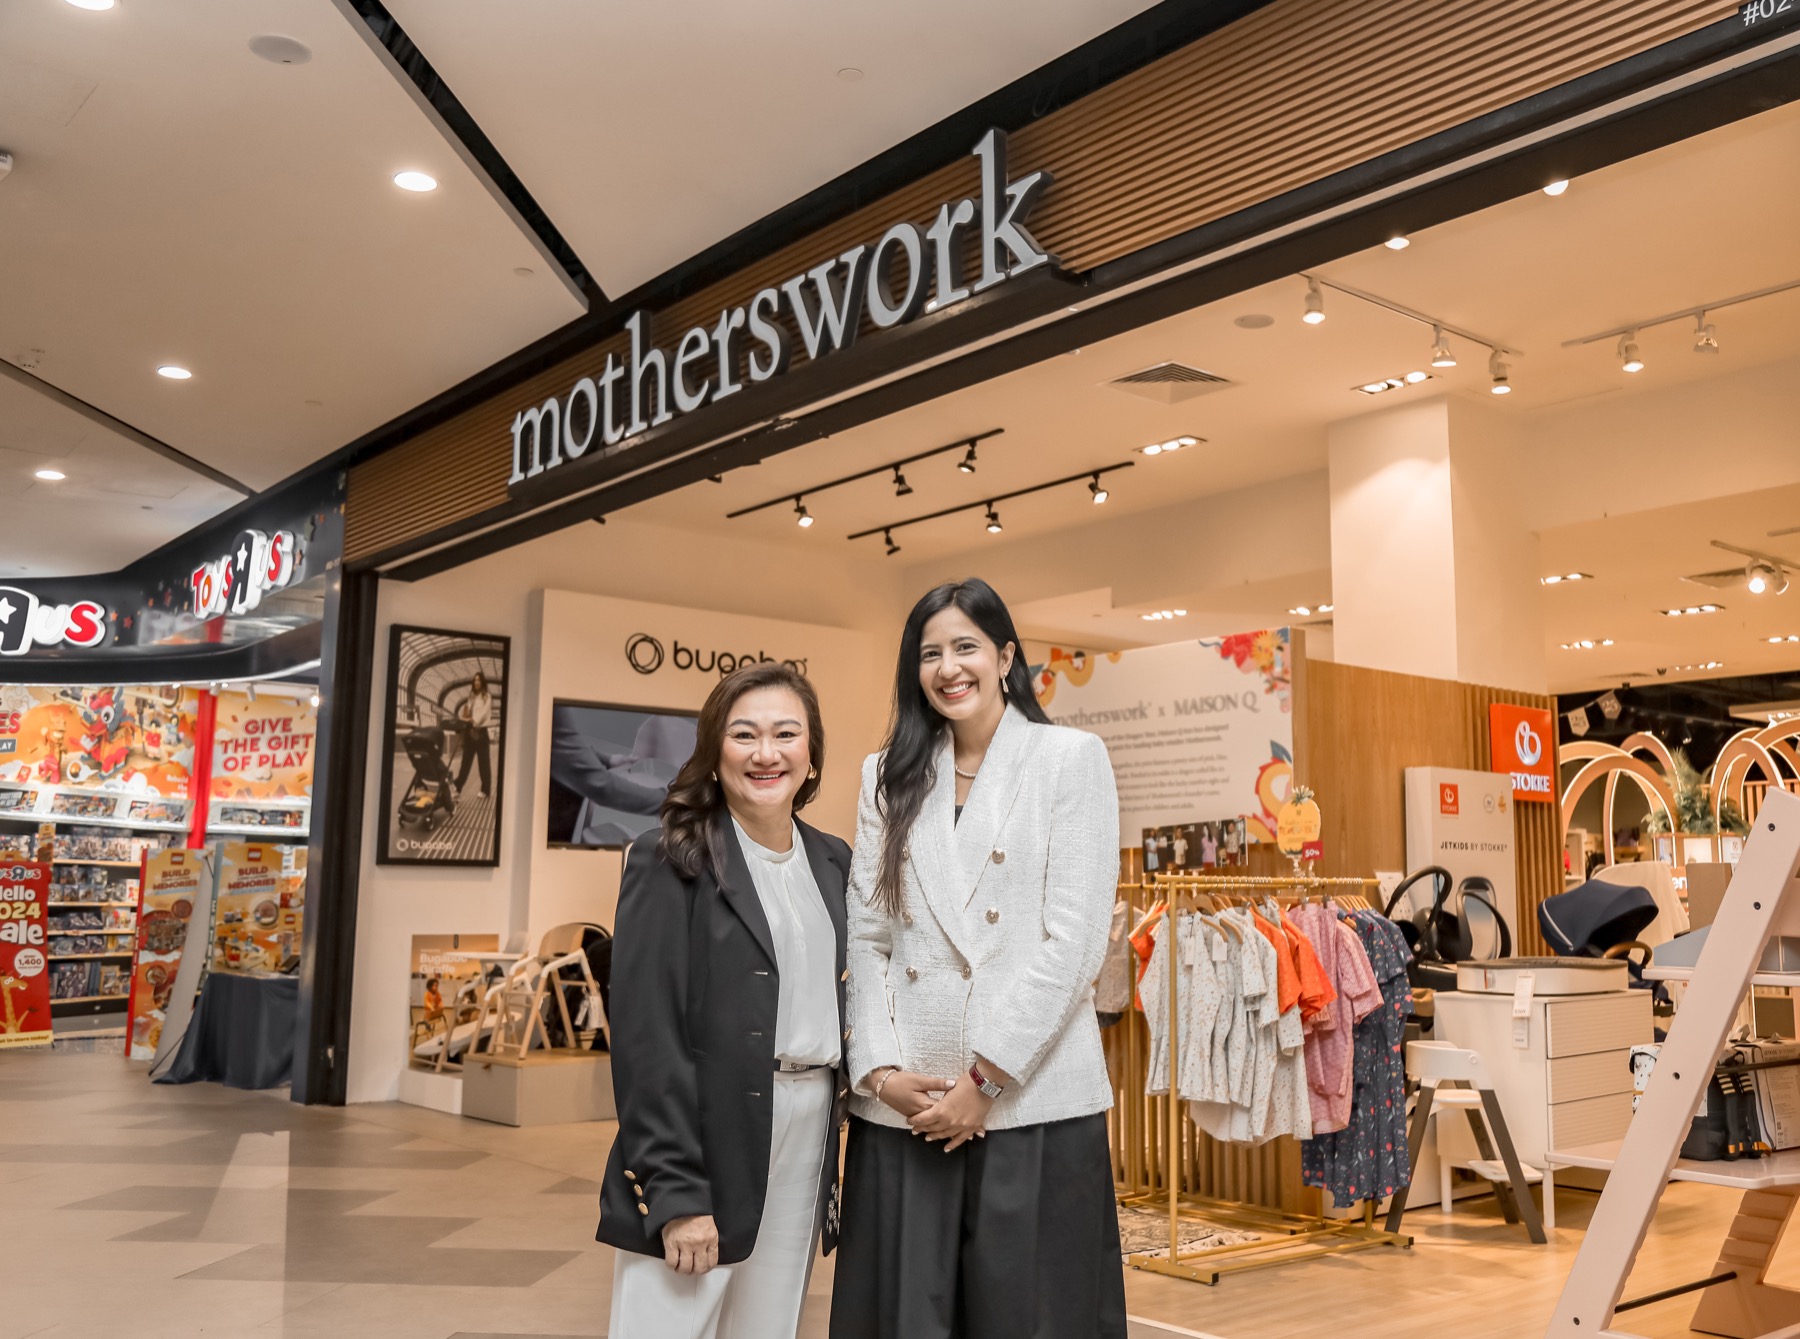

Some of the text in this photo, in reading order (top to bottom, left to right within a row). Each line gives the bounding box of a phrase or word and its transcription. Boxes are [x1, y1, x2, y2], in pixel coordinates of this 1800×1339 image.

[508, 127, 1054, 484] motherswork
[1174, 693, 1239, 717] MAISON
[1243, 691, 1260, 713] Q
[245, 718, 292, 734] GIVE
[221, 733, 314, 754] THE GIFT
[224, 752, 308, 772] OF PLAY
[1510, 772, 1550, 792] STOKKE
[1441, 842, 1468, 850] JETKIDS
[1471, 842, 1478, 851] BY
[162, 868, 190, 878] BUILD
[238, 866, 268, 876] BUILD
[153, 879, 198, 890] MEMORIES
[228, 878, 276, 890] MEMORIES
